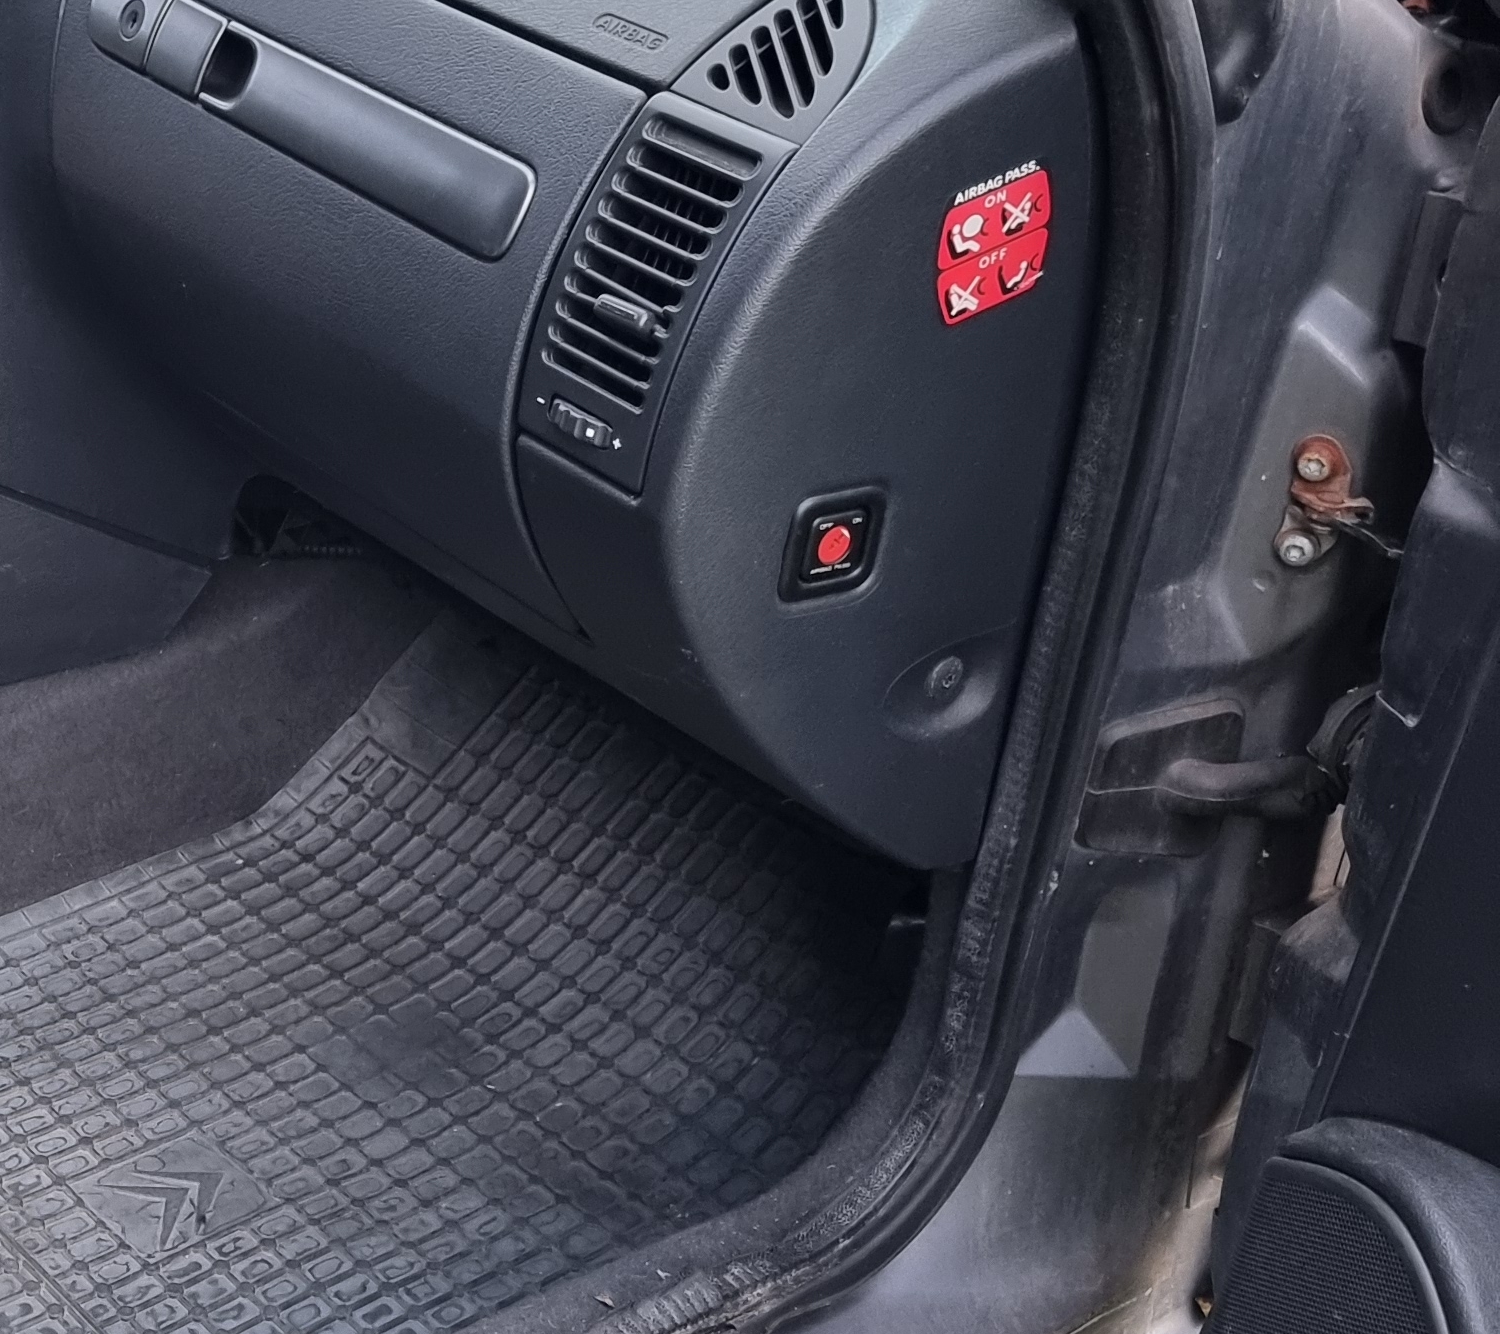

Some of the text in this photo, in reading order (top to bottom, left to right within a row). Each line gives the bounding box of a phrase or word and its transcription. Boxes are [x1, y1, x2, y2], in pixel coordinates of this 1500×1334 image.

[596, 19, 663, 49] AIRBAG
[954, 160, 1041, 206] AIRBAG PASS.
[985, 190, 1006, 208] ON
[979, 248, 1007, 269] OFF
